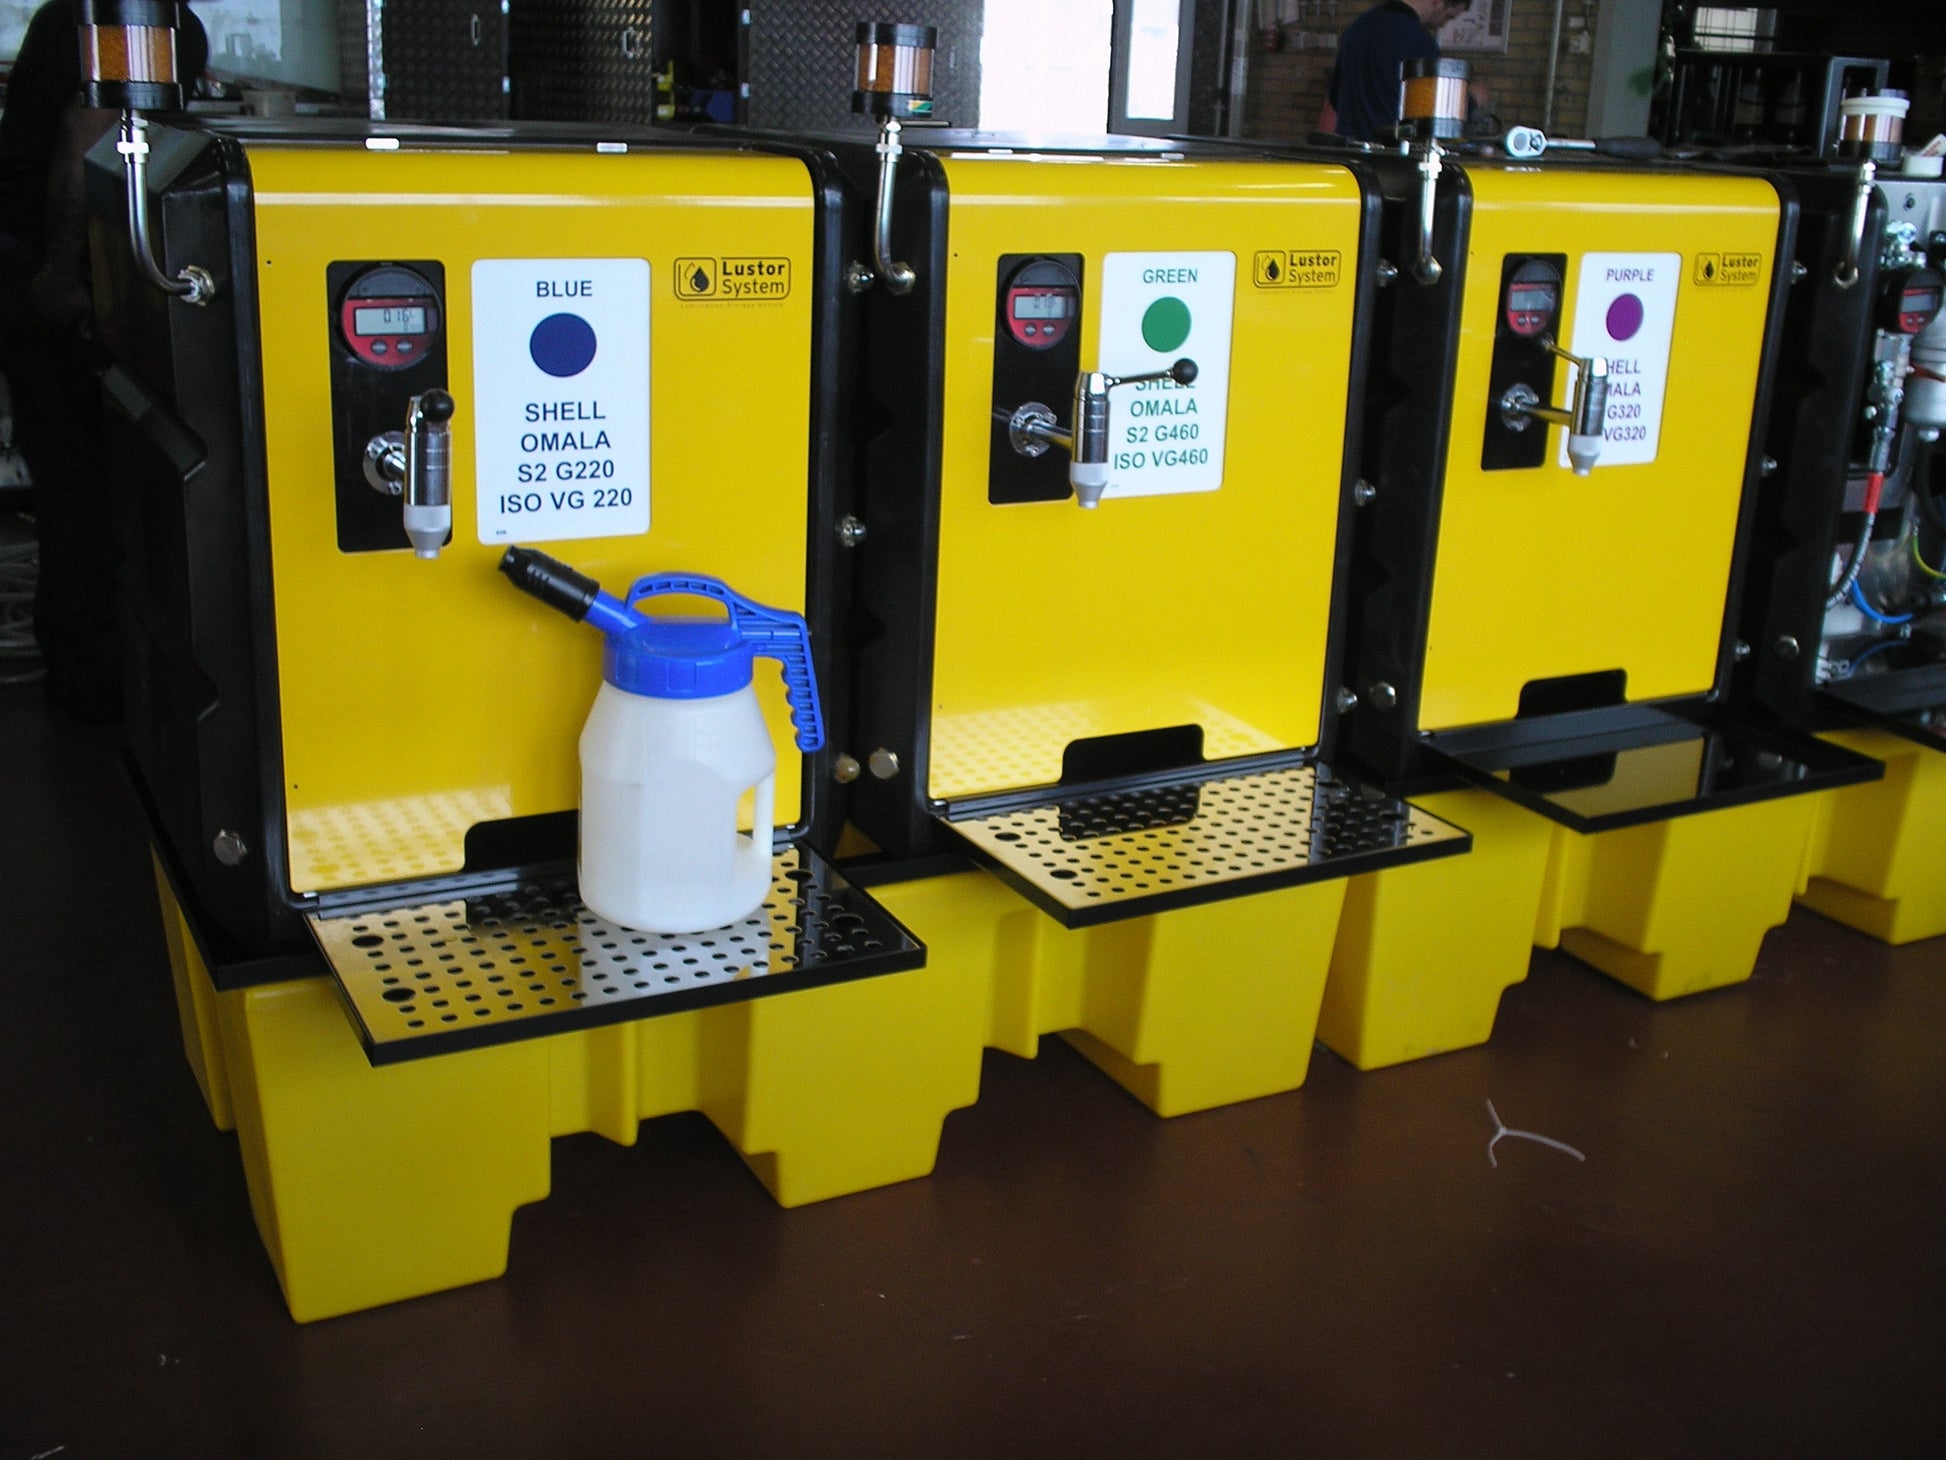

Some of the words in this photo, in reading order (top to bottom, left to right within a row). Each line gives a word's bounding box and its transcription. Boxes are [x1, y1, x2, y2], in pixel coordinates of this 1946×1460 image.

[722, 261, 785, 276] Lustor
[1290, 254, 1337, 267] Lustor
[1722, 256, 1759, 268] Lustor
[1143, 268, 1198, 284] GREEN
[1289, 268, 1336, 285] System
[1606, 268, 1655, 283] PURPLE
[1720, 269, 1757, 284] System
[536, 280, 593, 298] BLUE
[722, 278, 785, 297] System
[1607, 358, 1642, 374] HELL
[525, 401, 606, 422] SHELL
[1130, 398, 1198, 417] OMALA
[1607, 403, 1642, 419] G320
[520, 430, 611, 452] OMALA
[1126, 426, 1149, 443] S2
[1155, 423, 1199, 442] G460
[1603, 425, 1647, 441] VG320
[1114, 452, 1146, 470] ISO
[1152, 448, 1209, 468] VG460
[518, 463, 547, 483] S2
[556, 459, 615, 480] G220
[500, 493, 542, 514] ISO
[550, 490, 585, 511] VG
[593, 487, 633, 508] 220
